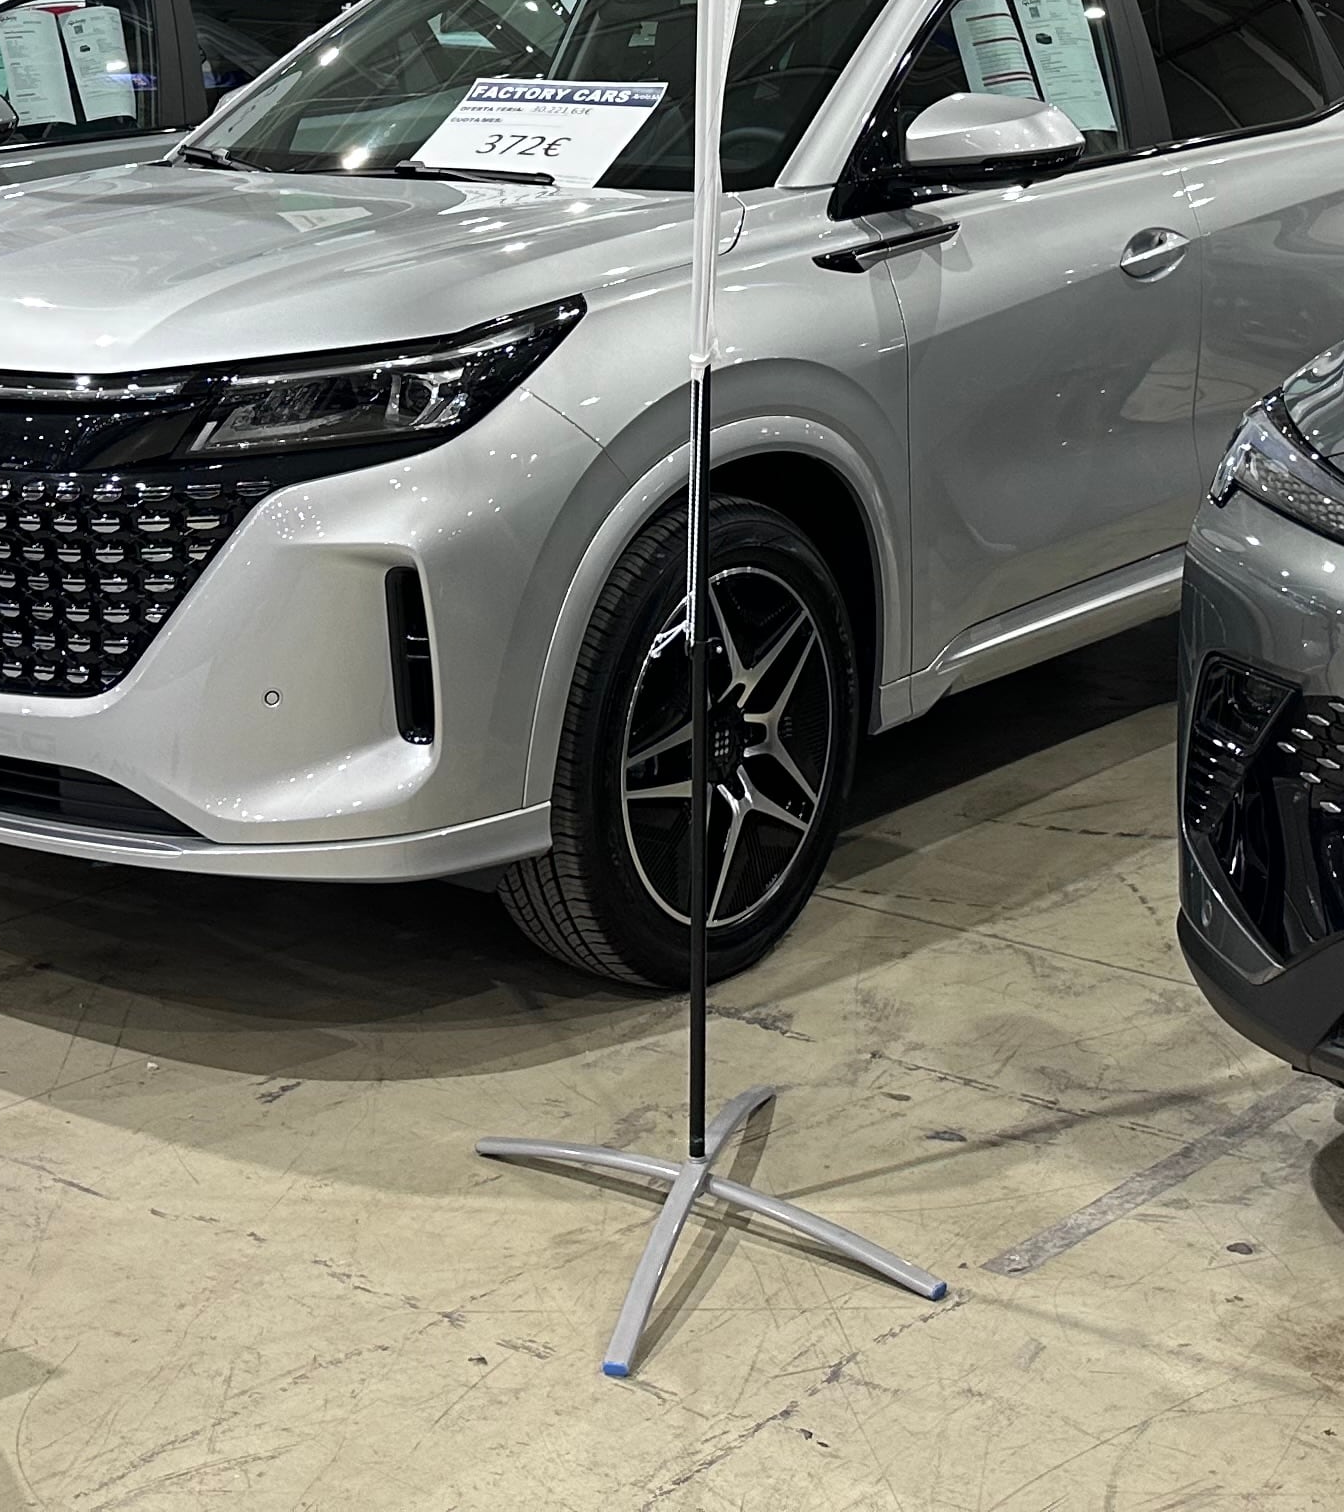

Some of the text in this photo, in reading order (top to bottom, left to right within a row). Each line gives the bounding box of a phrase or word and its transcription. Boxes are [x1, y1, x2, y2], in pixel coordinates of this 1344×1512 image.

[471, 85, 571, 101] FACTORY
[573, 88, 632, 103] CARS
[475, 134, 571, 157] 372€
